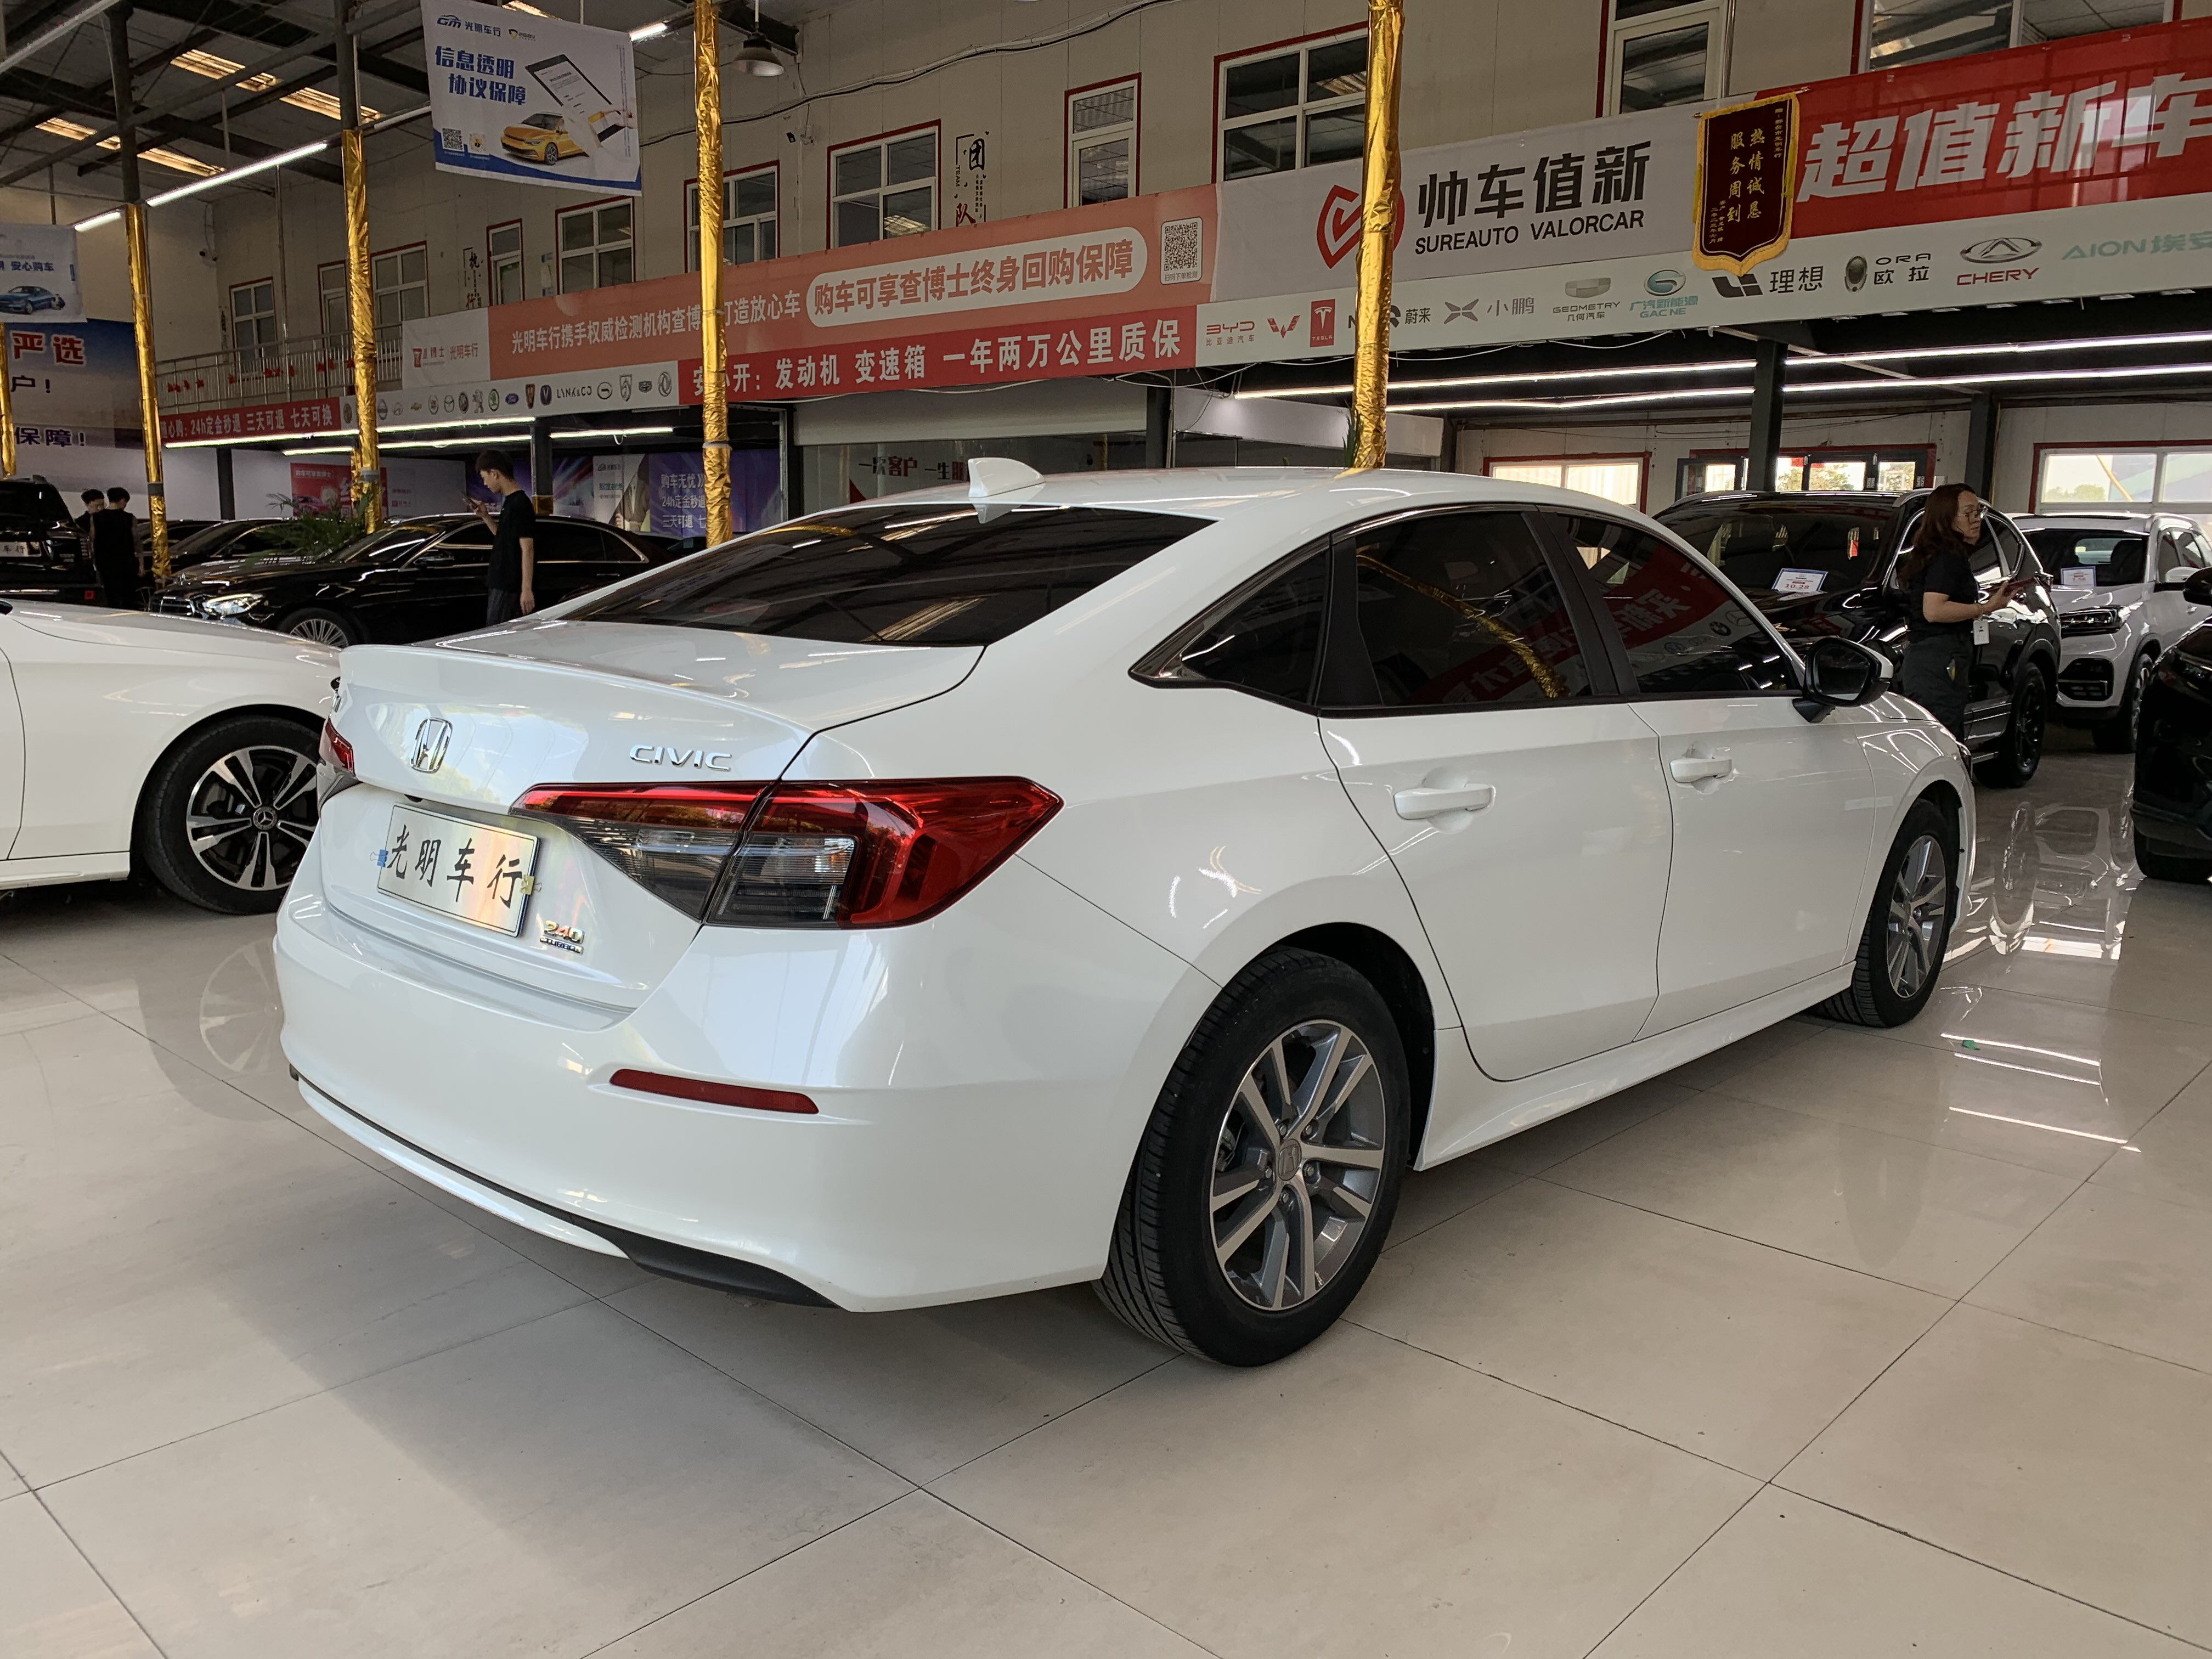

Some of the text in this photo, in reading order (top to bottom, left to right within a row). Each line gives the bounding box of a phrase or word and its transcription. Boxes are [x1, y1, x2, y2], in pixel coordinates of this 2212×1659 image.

[465, 21, 501, 37] 光明车行
[435, 46, 515, 79] 信息透明
[448, 74, 527, 105] 协议保障
[1796, 72, 2212, 202] 超值新车
[969, 138, 985, 171] 团
[1418, 140, 1651, 228] 帅车值新
[1726, 131, 1746, 223] 服务周到
[1747, 128, 1765, 219] 热情诚恳
[956, 202, 977, 227] 队
[1415, 210, 1644, 255] SUREAUTO VALORCAR
[1876, 253, 1932, 266] ORA
[2062, 238, 2147, 260] AION
[815, 239, 1133, 316] 购车可享查博士终身回购保障
[1164, 271, 1198, 282] 扫码下单检测
[1769, 266, 1824, 294] 理想
[1873, 266, 1930, 285] 欧拉
[1956, 267, 2040, 286] CHERY
[1487, 297, 1535, 317] 小鹏
[1552, 302, 1621, 314] GEOMETRY
[1629, 295, 1699, 311] 广汽新能源
[1639, 308, 1687, 318] GAC NE
[1404, 307, 1431, 325] 蔚来
[1567, 311, 1605, 321] 几何汽车
[1206, 321, 1255, 335] BYD
[12, 332, 85, 365] 严选
[449, 343, 478, 360] 光明车行
[1206, 334, 1255, 347] 比亚迪汽车
[776, 354, 840, 390] 发动机
[855, 345, 926, 385] 变速箱
[943, 319, 1181, 374] 一年两万公里质保
[191, 413, 242, 435] 24h定金秒退
[246, 409, 285, 431] 三天可退
[290, 404, 333, 428] 七天可换
[661, 473, 696, 489] 购车无忧
[662, 515, 693, 528] 三天可退
[630, 743, 732, 772] CIVIC
[386, 824, 523, 910] 光明车行
[544, 920, 585, 944] 240
